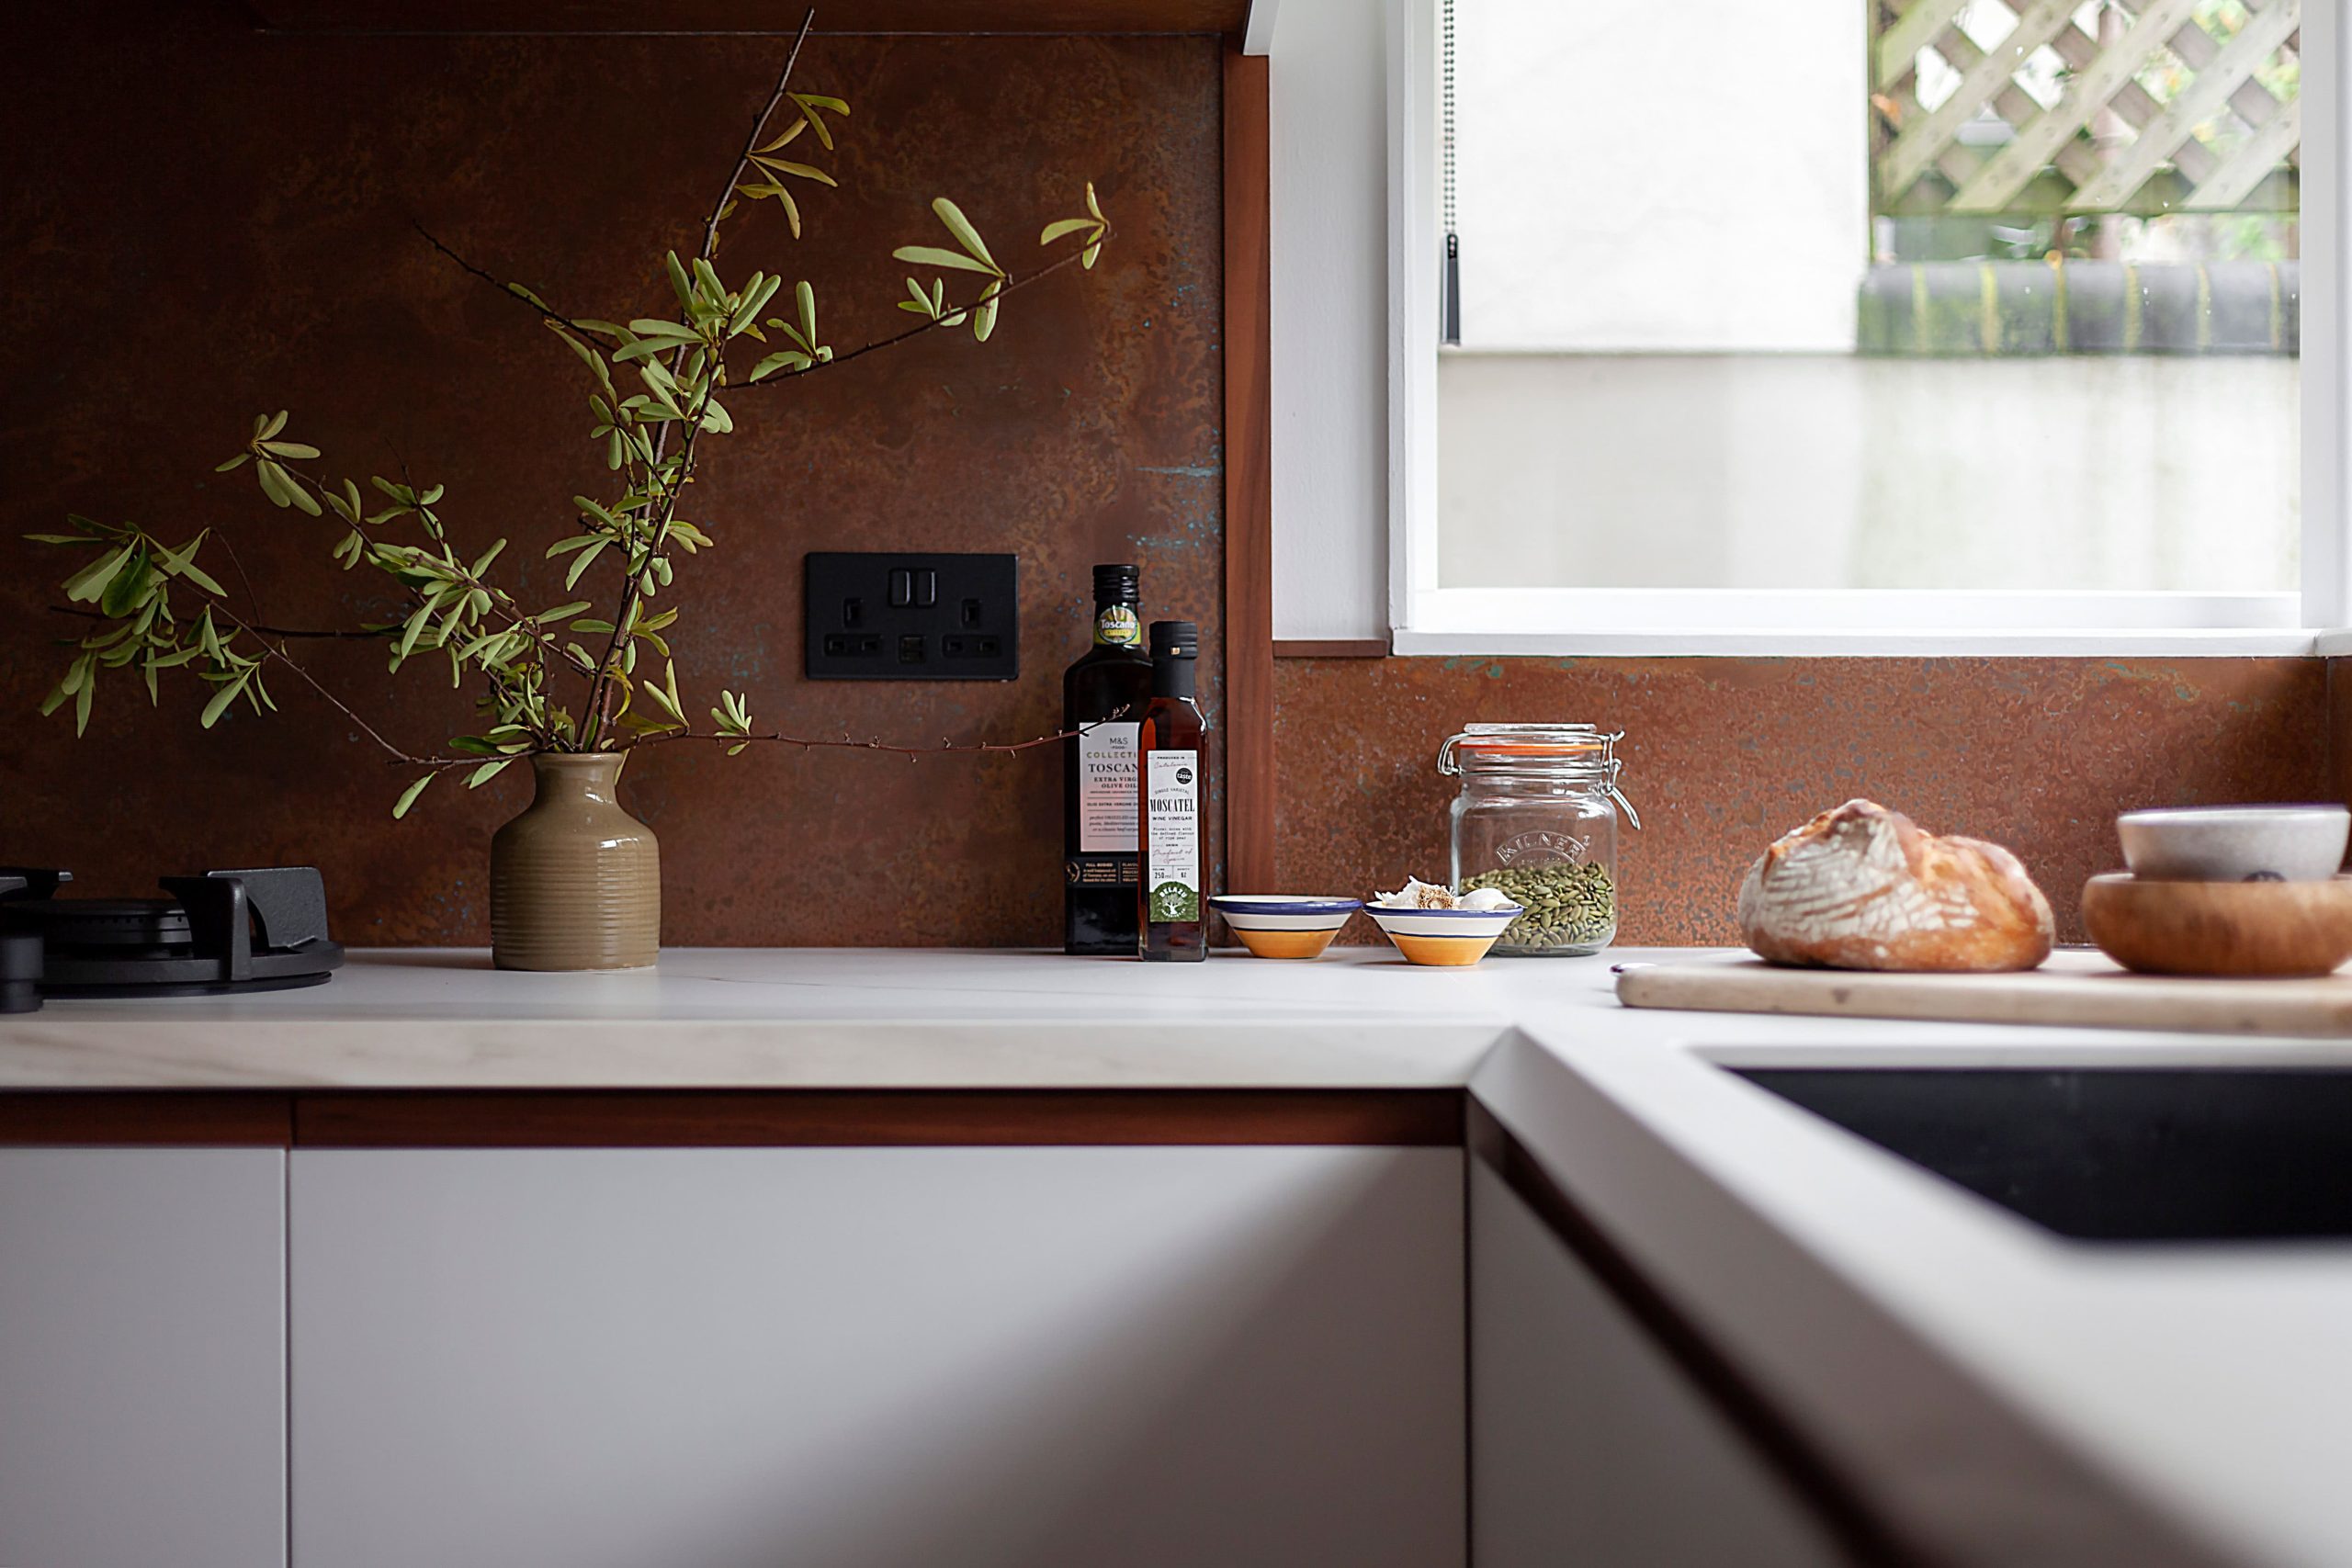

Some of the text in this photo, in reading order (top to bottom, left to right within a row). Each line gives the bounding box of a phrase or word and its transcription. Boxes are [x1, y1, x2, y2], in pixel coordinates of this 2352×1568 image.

[1088, 763, 1138, 773] TOSCAN
[1150, 798, 1195, 812] MOSCATEL
[1500, 833, 1581, 860] KILNER
[1159, 886, 1188, 898] BELAZU
